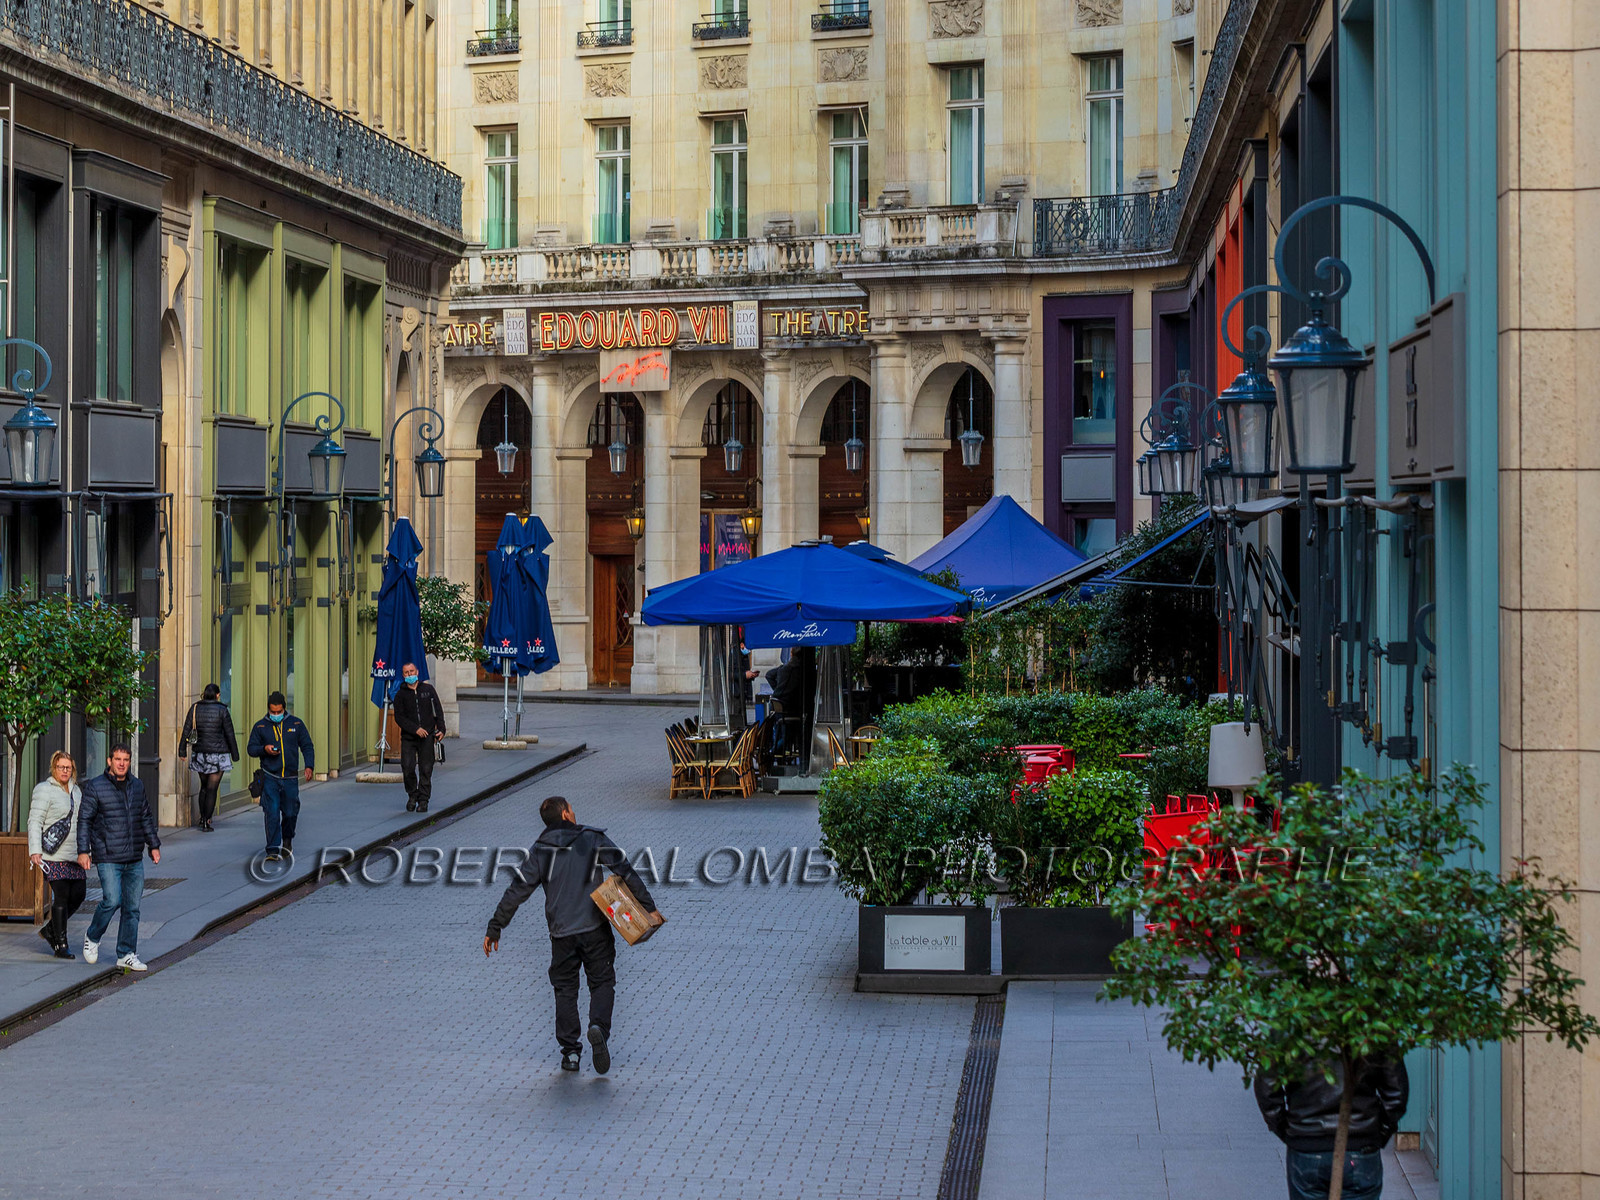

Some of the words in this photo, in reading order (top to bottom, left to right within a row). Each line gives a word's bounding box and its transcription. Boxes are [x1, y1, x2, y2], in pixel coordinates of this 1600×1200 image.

[736, 312, 756, 322] EDO
[770, 309, 870, 336] THEATRE
[507, 320, 525, 330] EDO
[539, 308, 678, 351] EDOUARD
[687, 305, 729, 344] VII
[736, 325, 756, 335] UAR
[507, 332, 525, 342] UAR
[718, 542, 751, 556] MAMAN
[901, 934, 929, 945] table
[931, 937, 942, 946] du
[943, 935, 957, 946] VII
